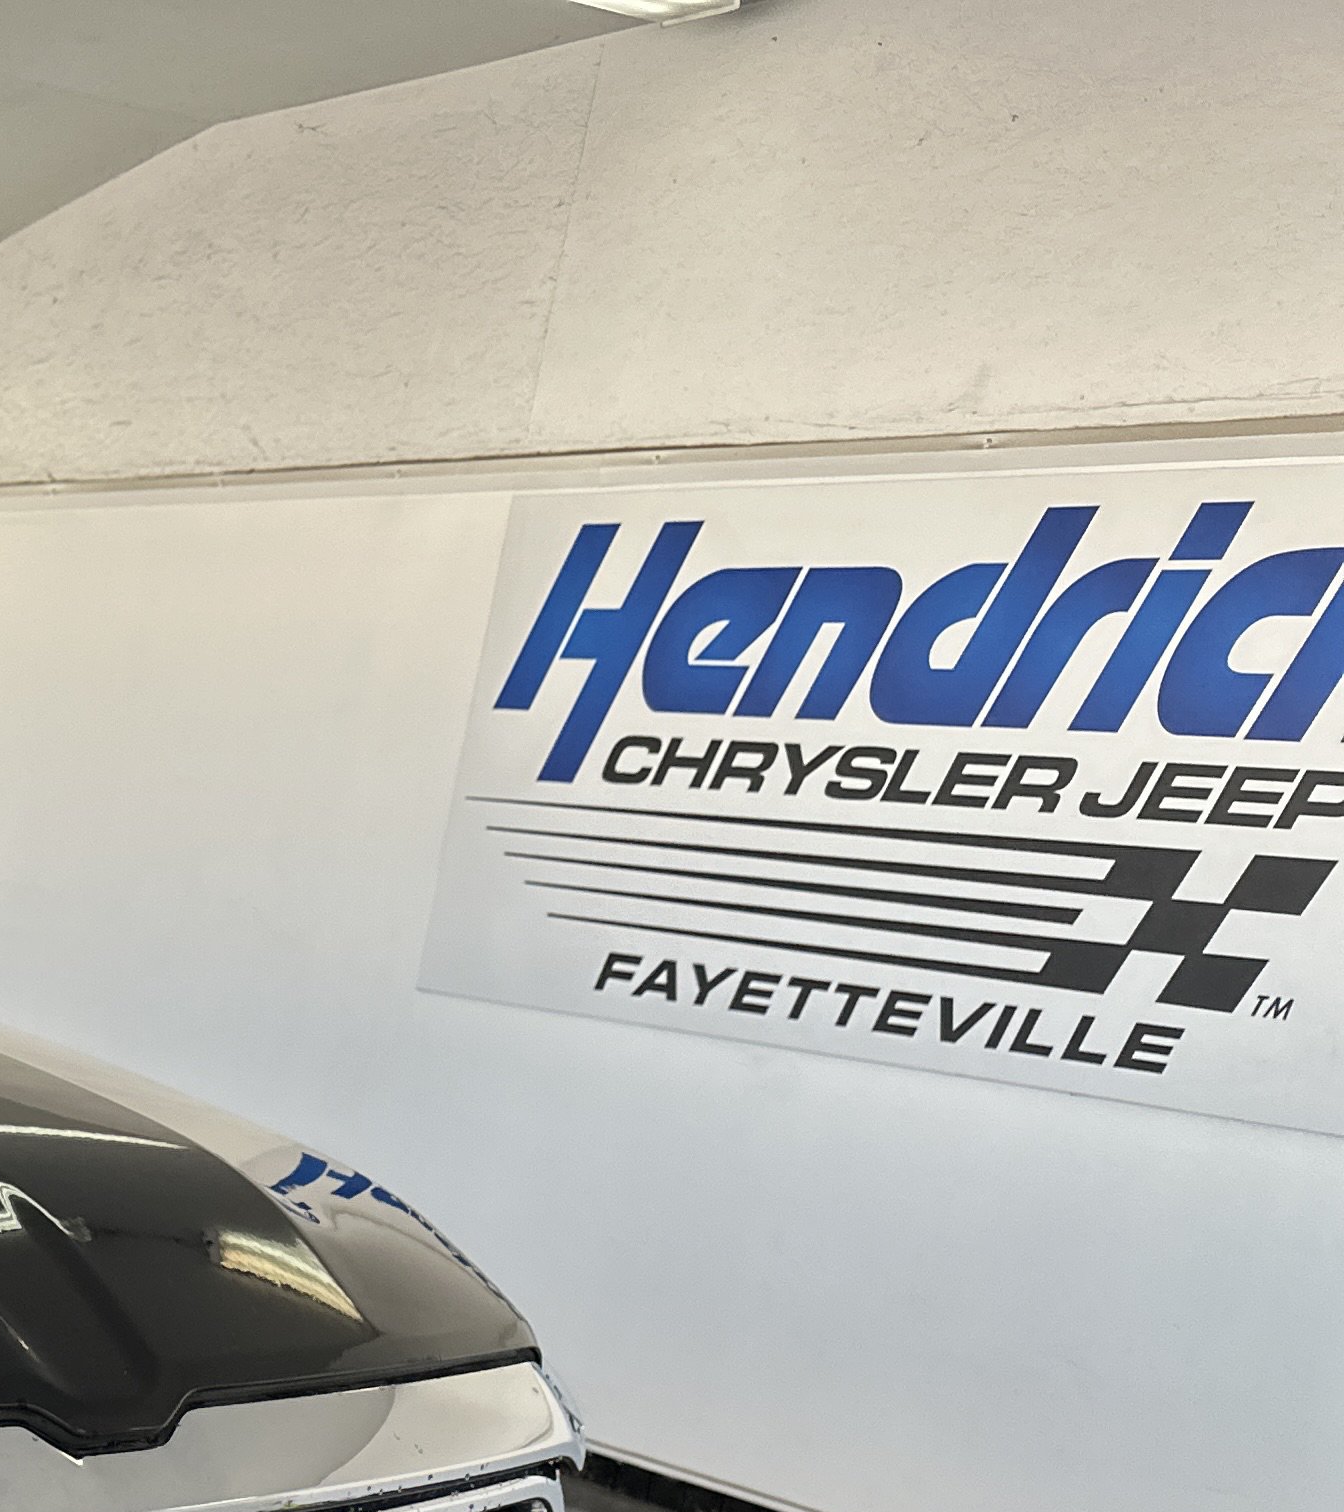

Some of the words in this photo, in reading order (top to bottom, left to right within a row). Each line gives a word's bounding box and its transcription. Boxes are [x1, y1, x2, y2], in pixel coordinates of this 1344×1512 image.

[601, 735, 1078, 814] CHRYSLER
[1079, 760, 1344, 829] JEEP
[594, 953, 1186, 1075] FAYETTEVILLE
[1250, 995, 1295, 1021] TM
